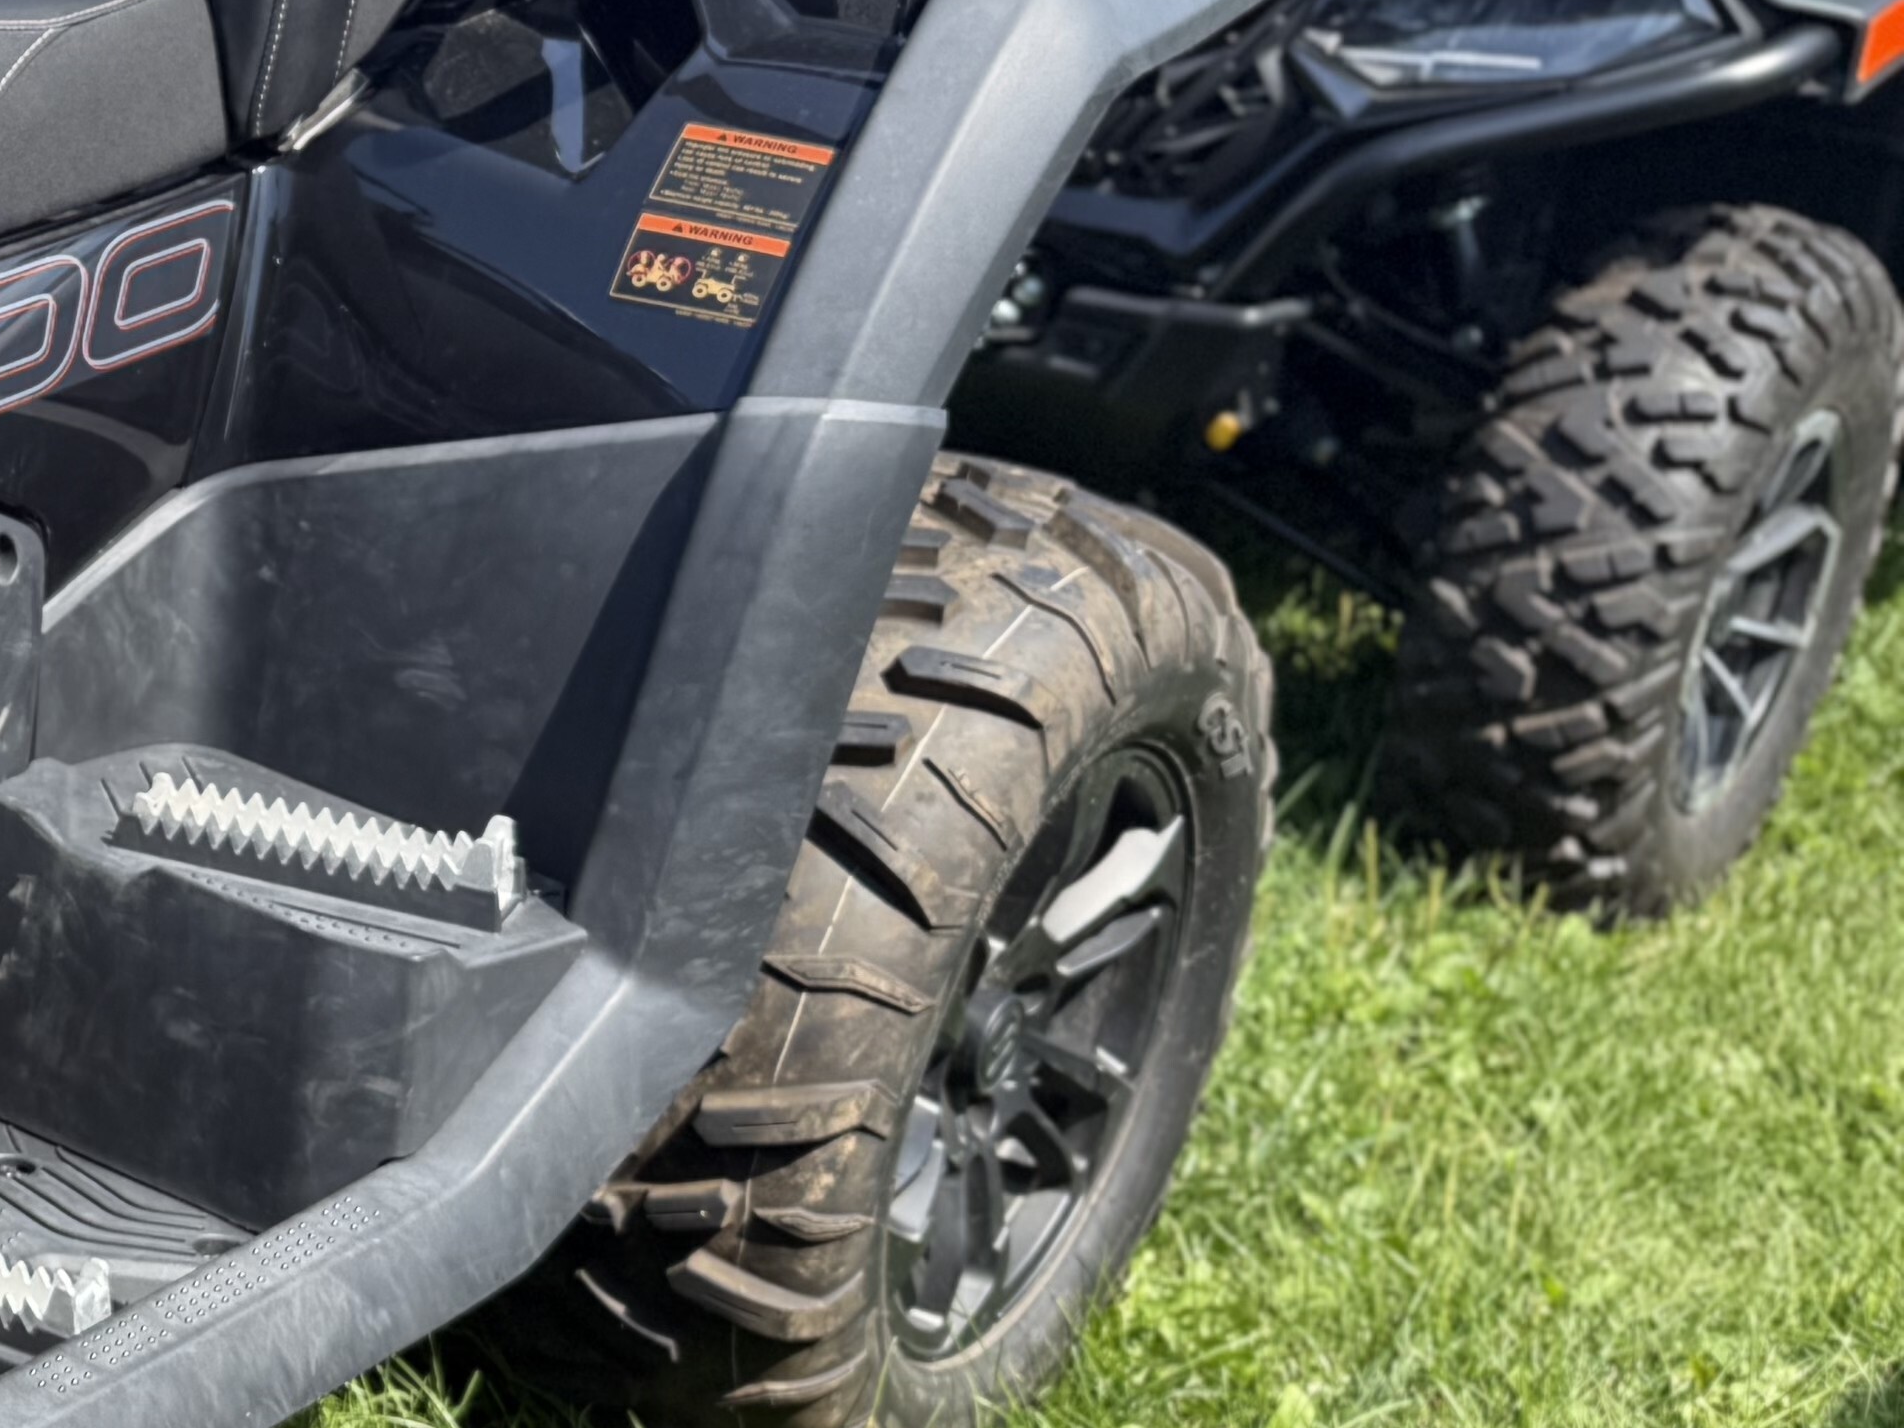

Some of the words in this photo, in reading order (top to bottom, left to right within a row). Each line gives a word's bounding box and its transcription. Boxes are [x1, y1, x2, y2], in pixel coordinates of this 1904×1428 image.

[732, 133, 798, 155] WARNING
[688, 224, 754, 247] WARNING
[1197, 691, 1253, 778] CST
